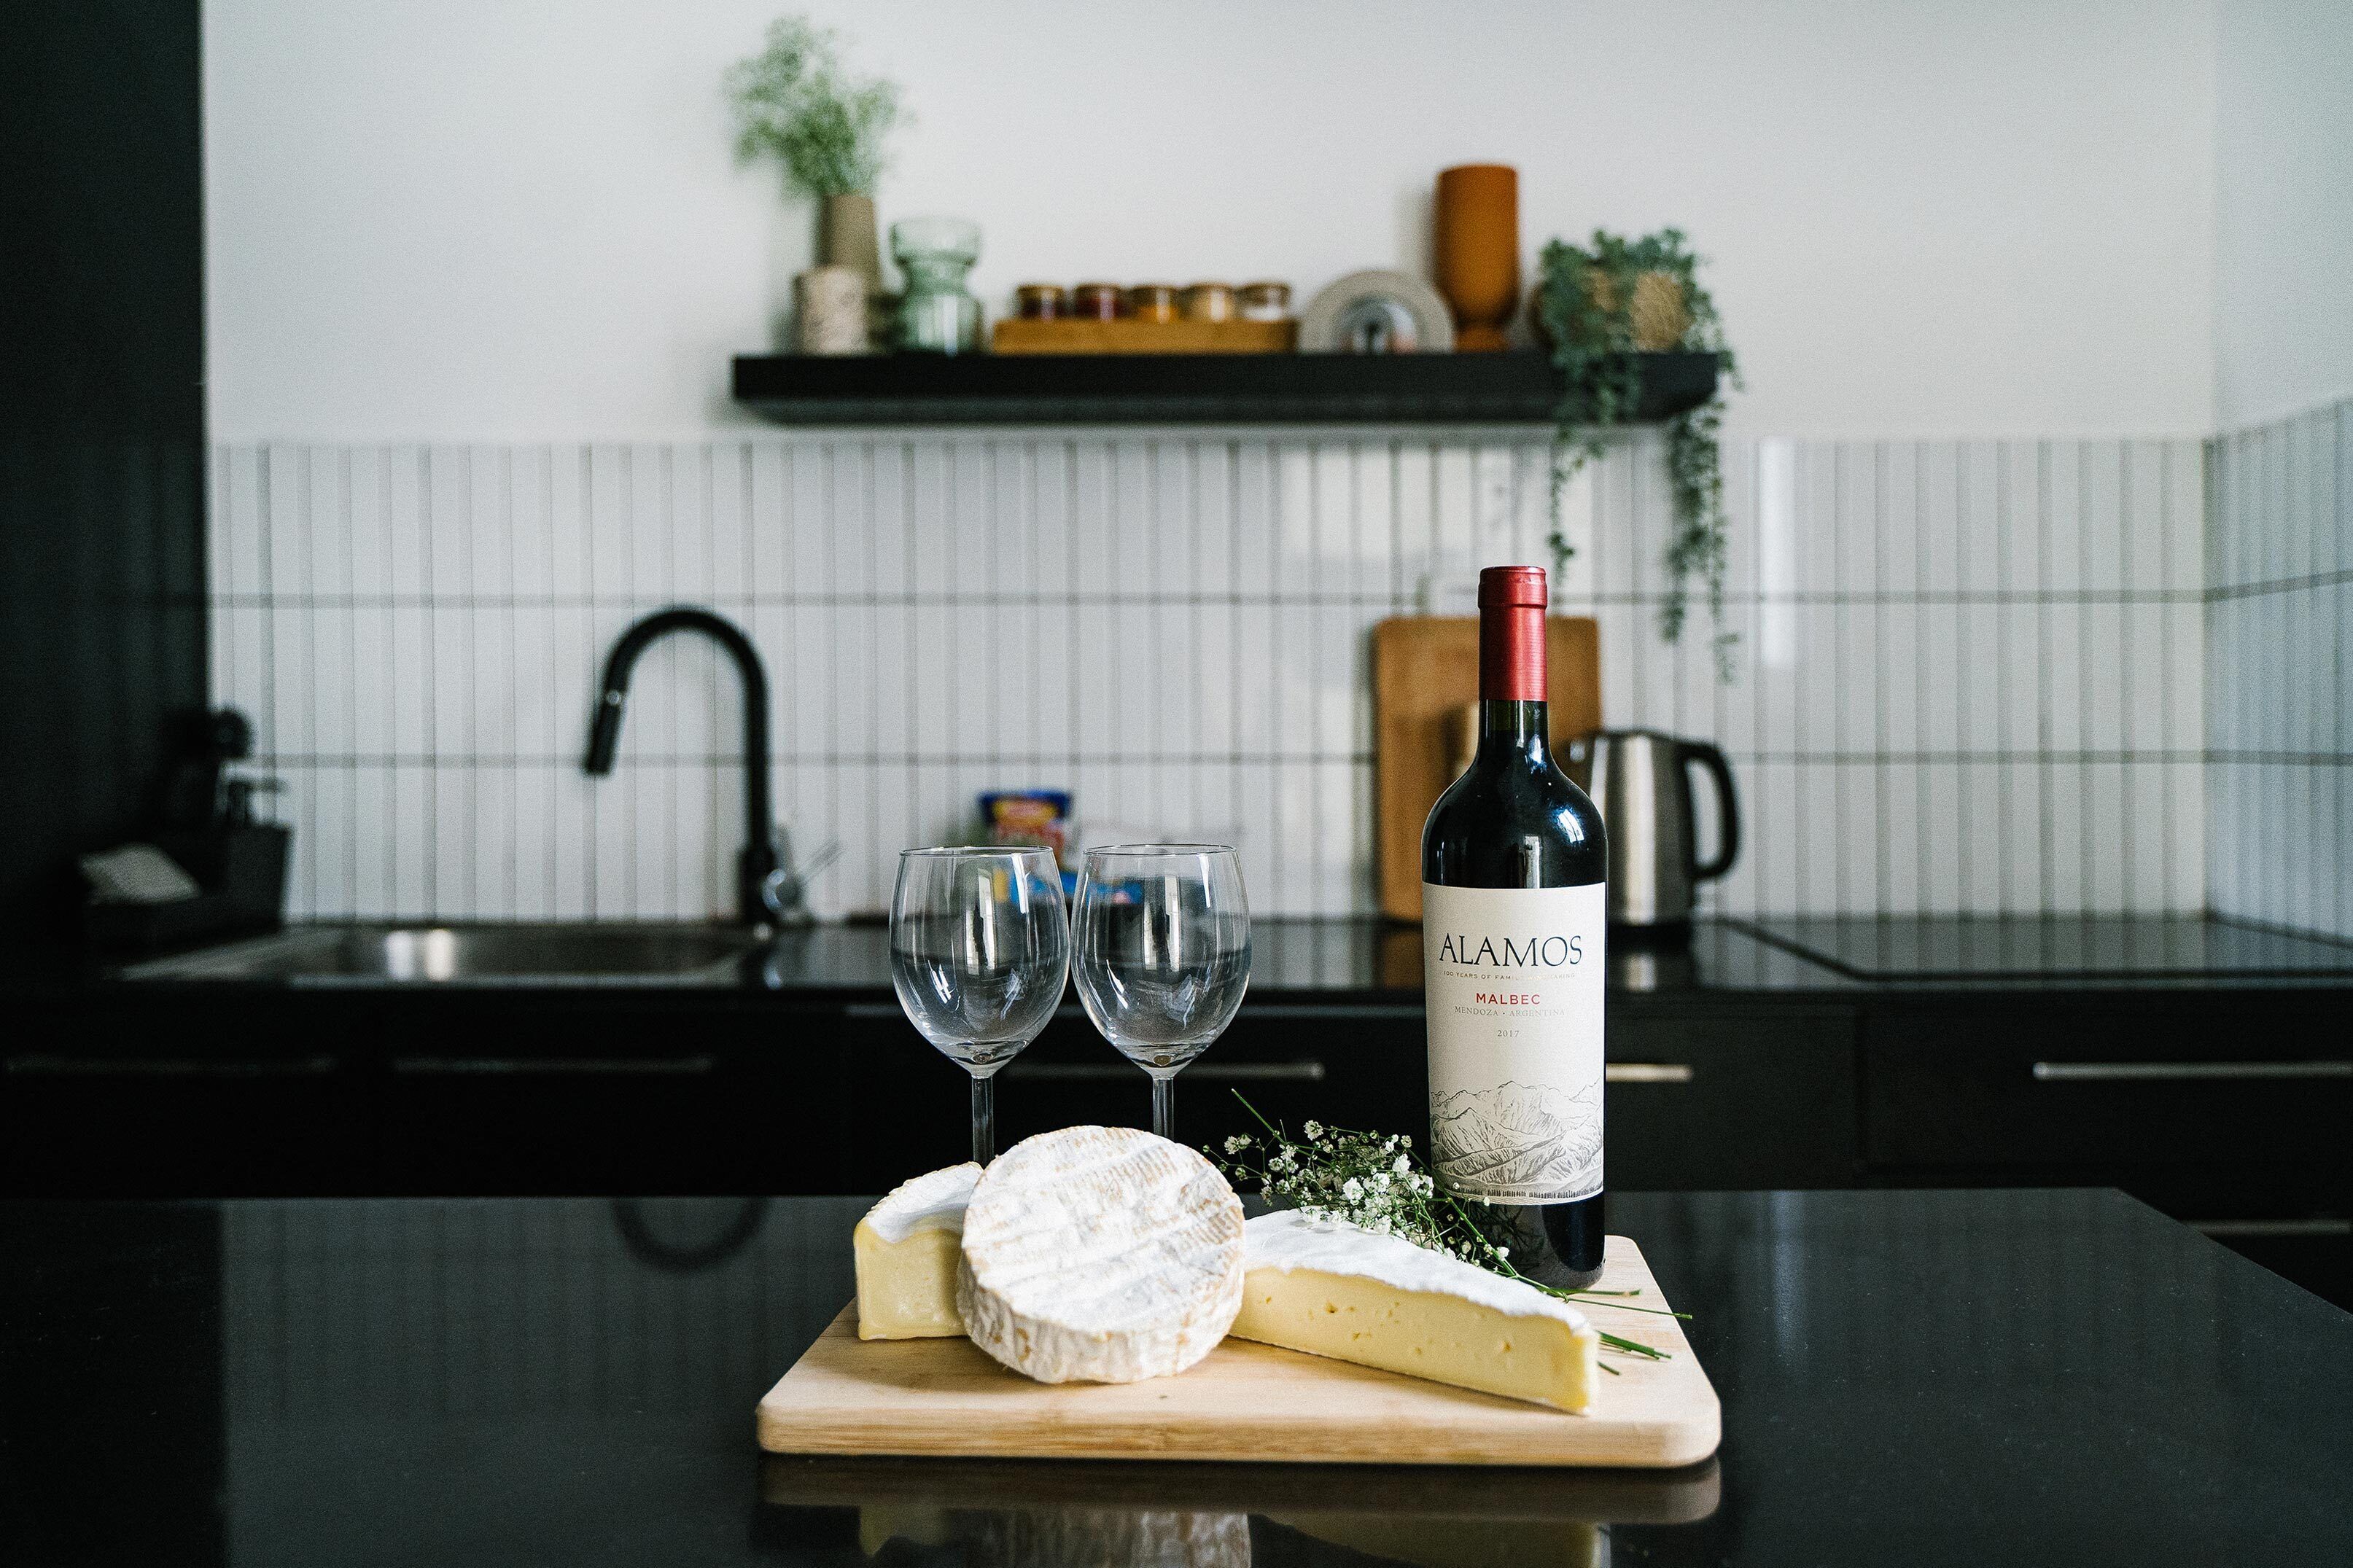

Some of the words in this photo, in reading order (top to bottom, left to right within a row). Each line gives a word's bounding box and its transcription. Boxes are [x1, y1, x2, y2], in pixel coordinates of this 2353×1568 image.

[1439, 933, 1582, 968] ALAMOS
[1455, 971, 1478, 979] YEARS
[1476, 993, 1540, 1005] MALBEC
[1454, 1006, 1498, 1016] MENDOZA
[1509, 1009, 1565, 1017] ARGENTINA
[1497, 1029, 1520, 1037] 2017
